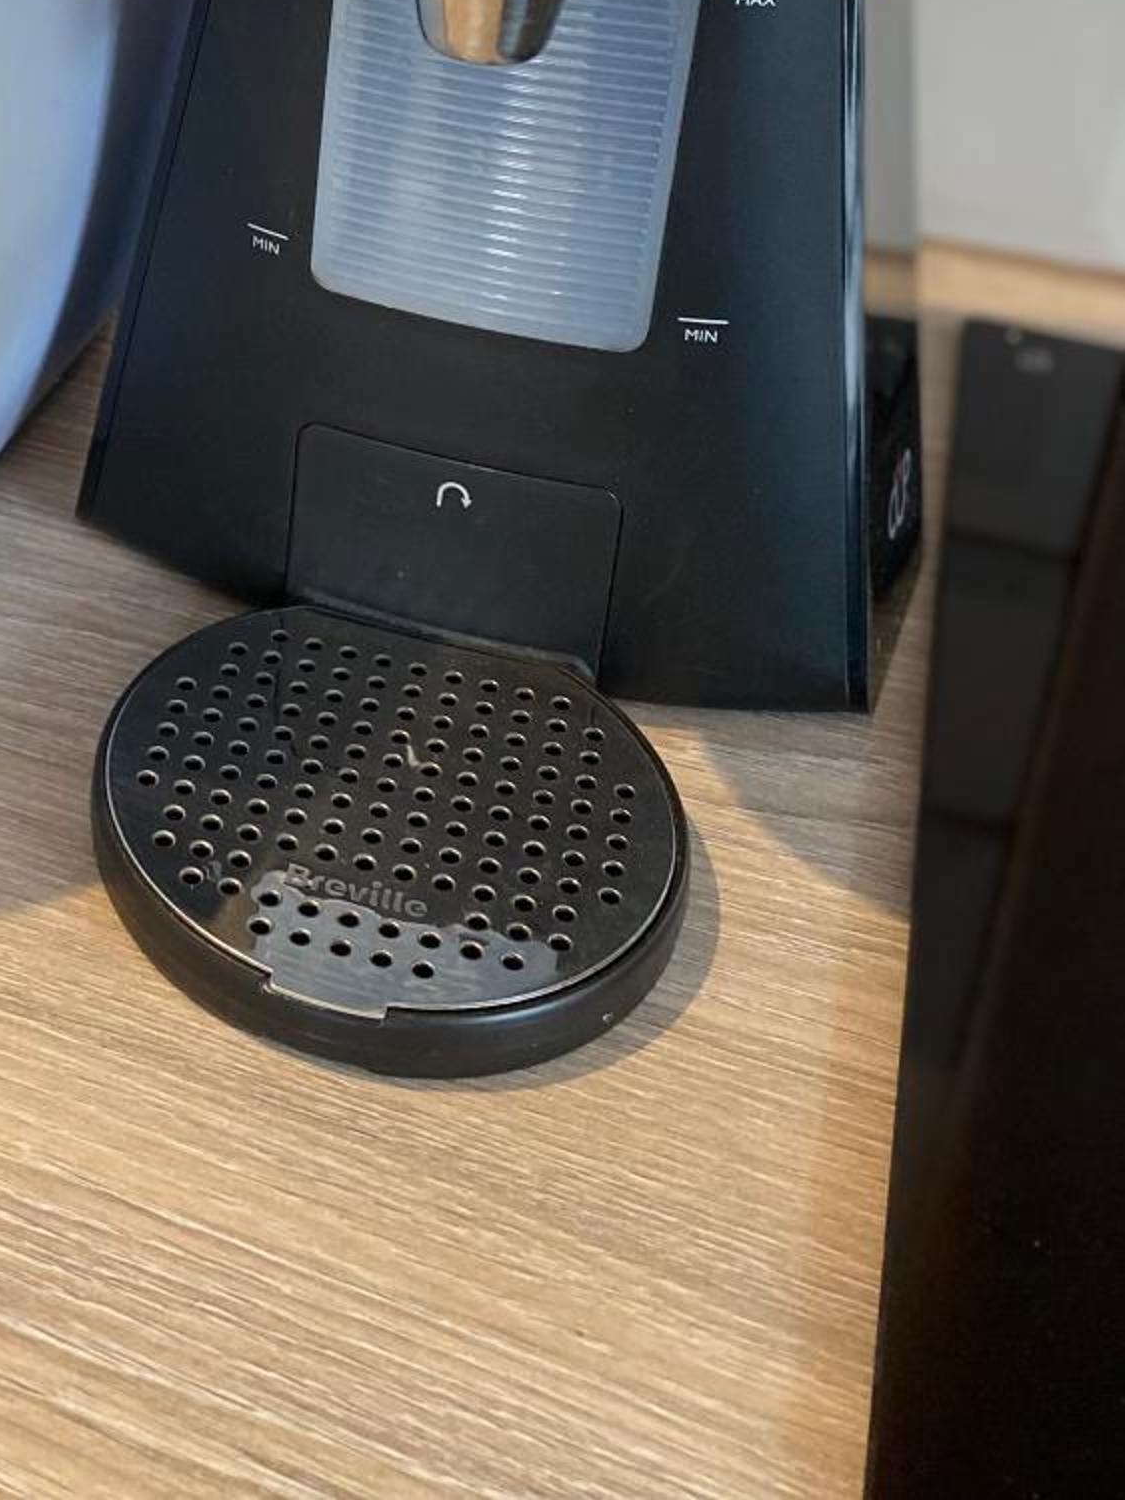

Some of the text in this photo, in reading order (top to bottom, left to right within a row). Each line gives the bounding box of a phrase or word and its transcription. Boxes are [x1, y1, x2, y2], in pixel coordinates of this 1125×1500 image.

[252, 234, 281, 255] MIN
[684, 328, 719, 343] MIN
[283, 862, 428, 917] Breville
